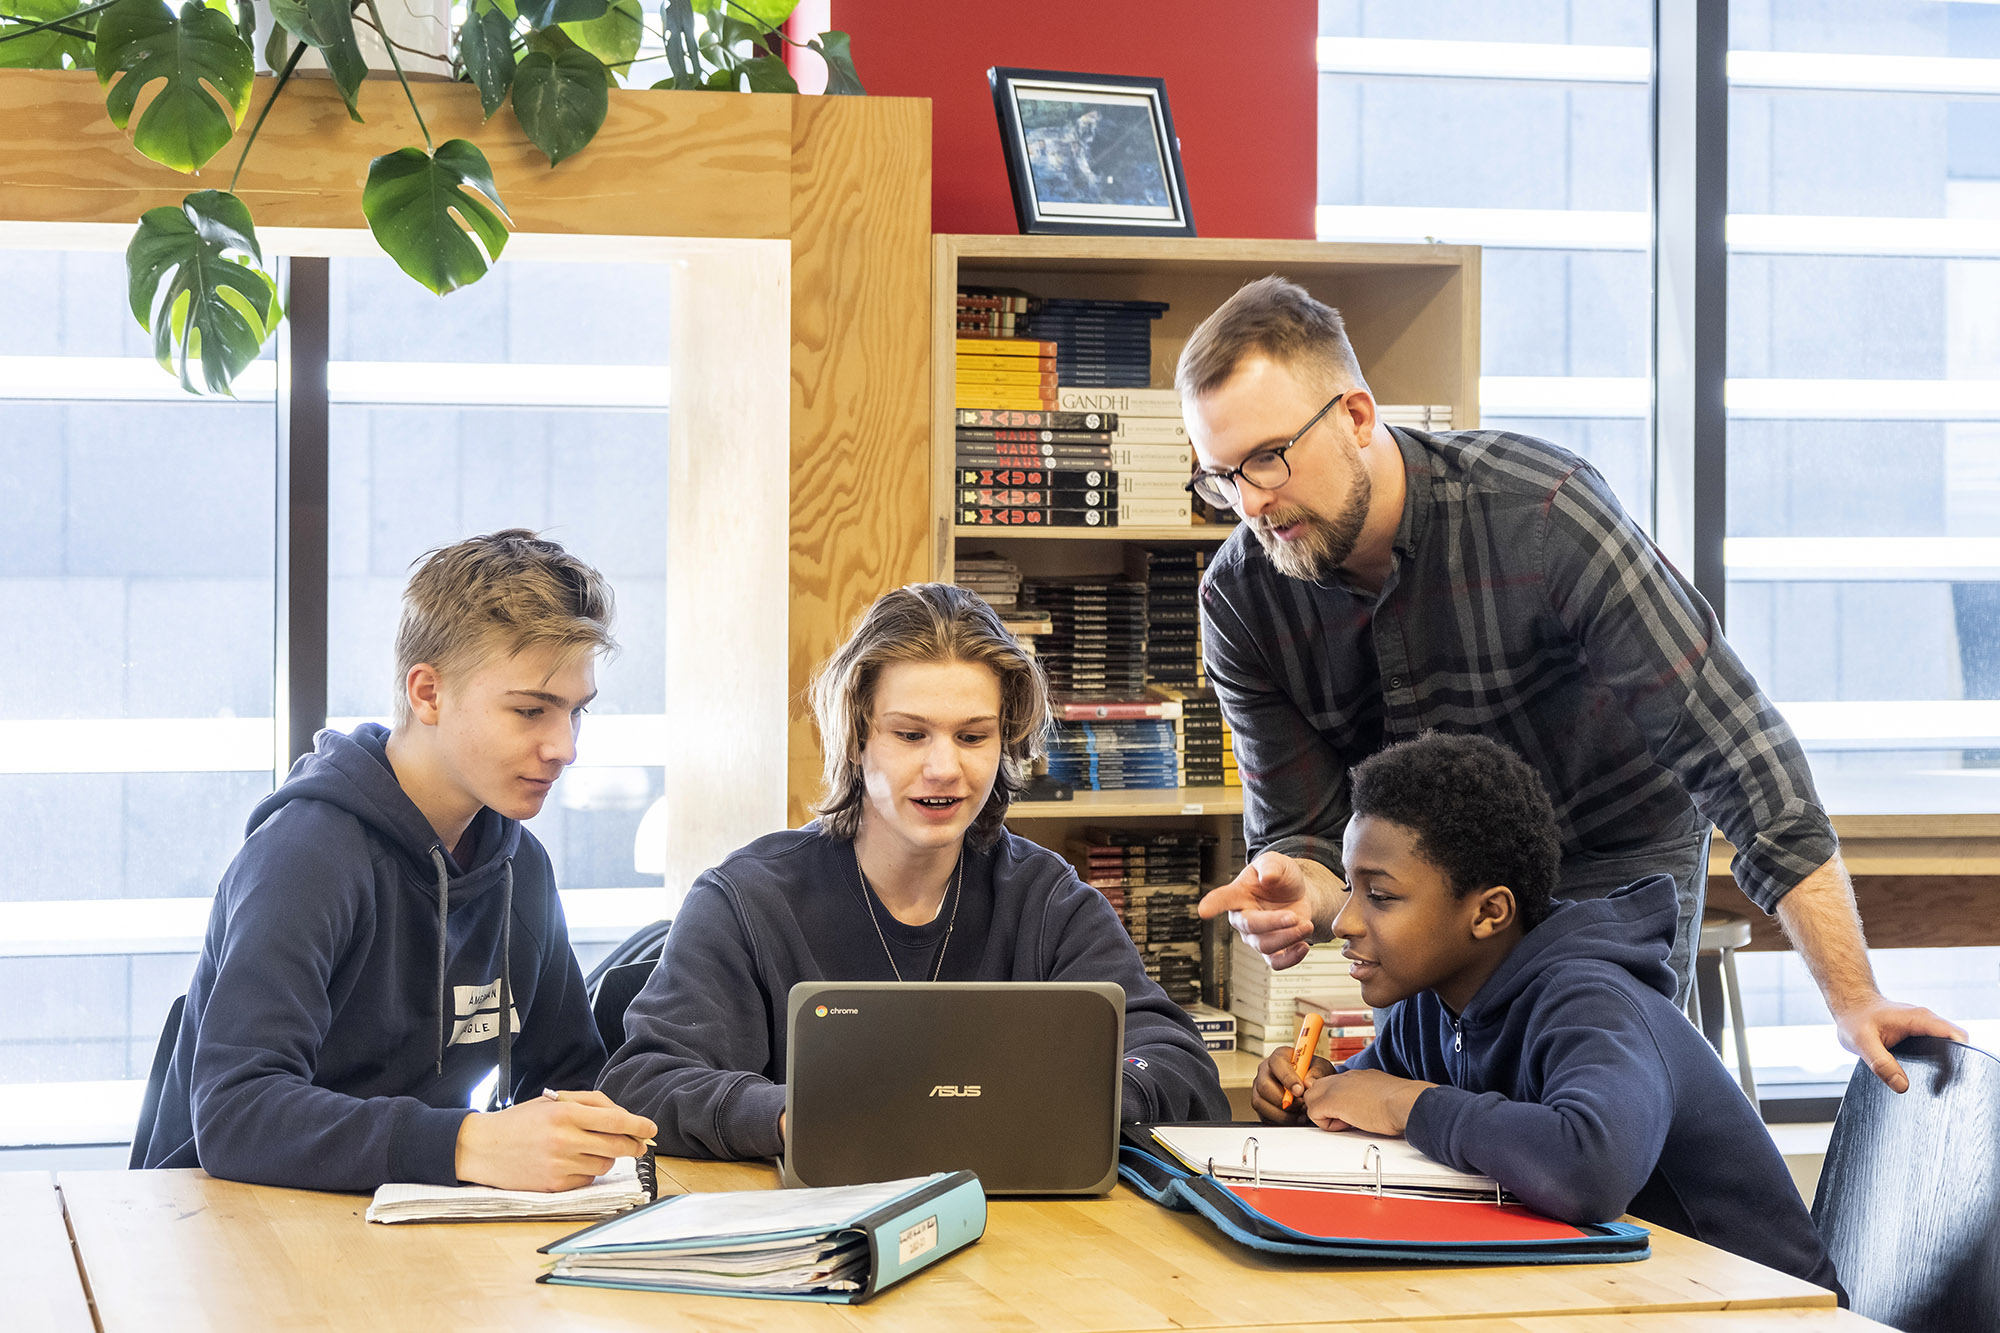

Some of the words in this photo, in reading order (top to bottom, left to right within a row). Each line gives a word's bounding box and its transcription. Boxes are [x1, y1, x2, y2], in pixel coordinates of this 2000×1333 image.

[1062, 394, 1129, 410] GANDHI
[980, 410, 1041, 427] MAUS
[995, 430, 1037, 441] MAUS
[996, 443, 1038, 455] MAUS
[1000, 456, 1041, 468] MAUS
[980, 470, 1041, 486] MAUS
[979, 490, 1041, 505] MAUS
[979, 509, 1041, 524] MAUS
[830, 1007, 858, 1015] chrome
[929, 1085, 981, 1097] ASUS
